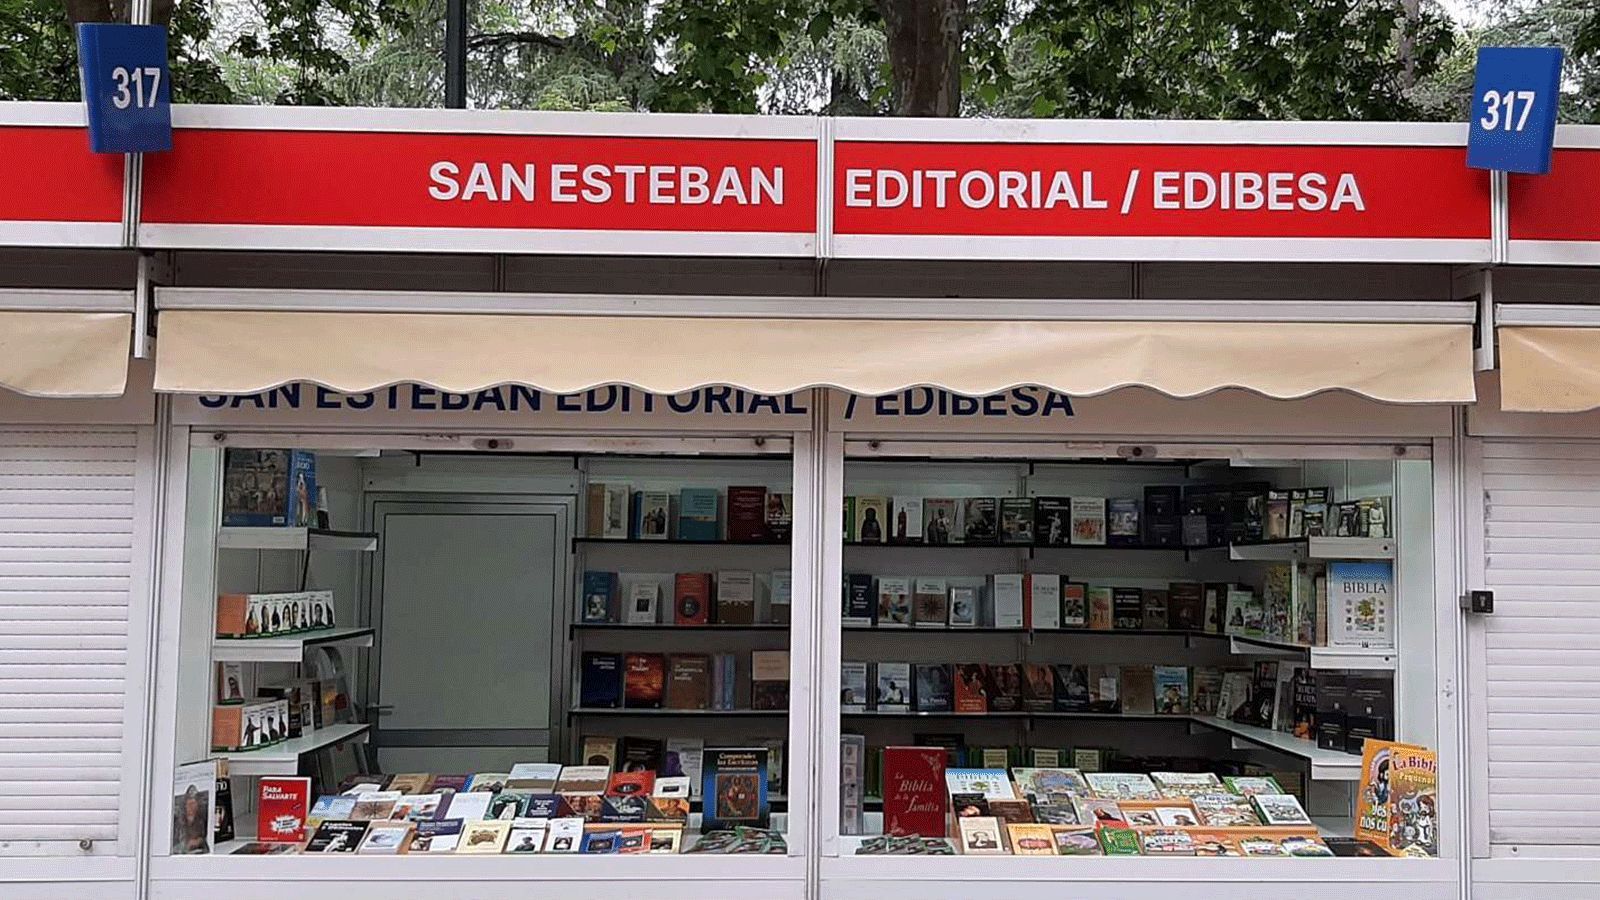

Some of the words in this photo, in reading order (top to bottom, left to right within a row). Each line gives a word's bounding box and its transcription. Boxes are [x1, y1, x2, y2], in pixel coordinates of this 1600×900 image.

[112, 67, 160, 109] 317
[1480, 90, 1535, 132] 317
[428, 161, 535, 202] SAN
[551, 164, 783, 205] ESTEBAN
[846, 169, 1108, 209] EDITORIAL
[1120, 170, 1140, 214] /
[1153, 172, 1366, 211] EDIBESA
[875, 387, 1075, 417] EDIBESA
[1343, 582, 1387, 594] BIBLIA
[899, 780, 933, 793] Biblia
